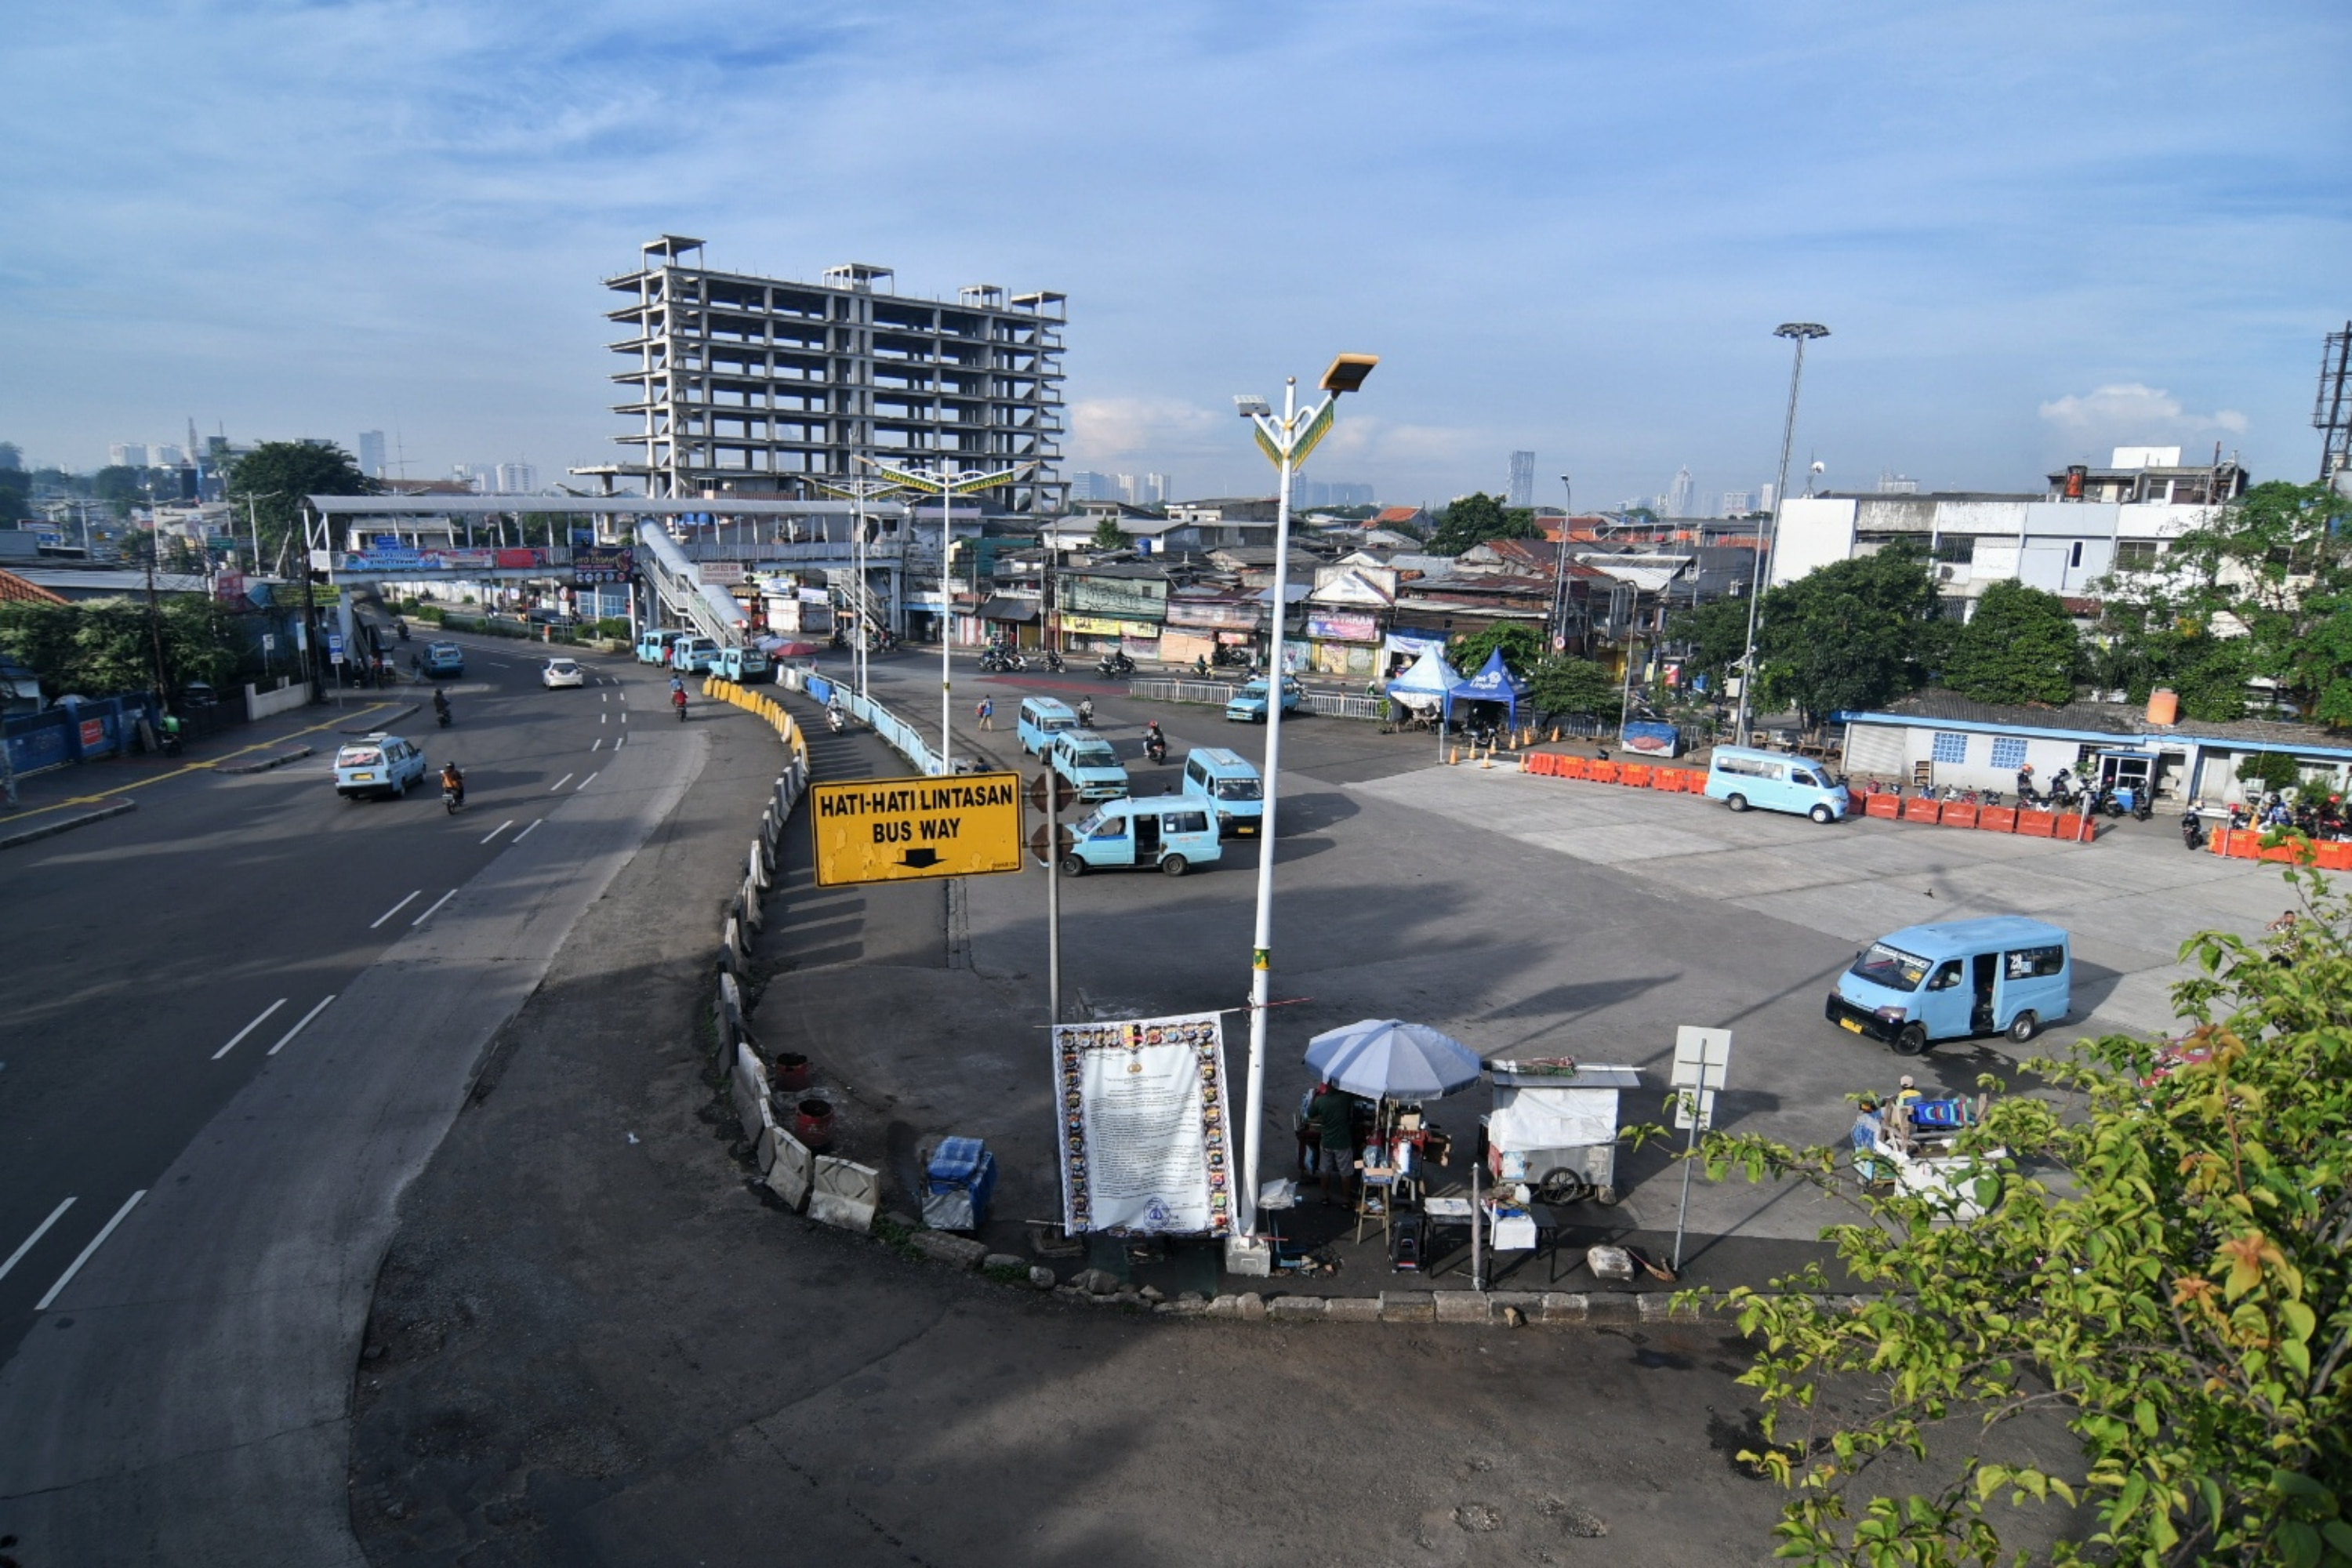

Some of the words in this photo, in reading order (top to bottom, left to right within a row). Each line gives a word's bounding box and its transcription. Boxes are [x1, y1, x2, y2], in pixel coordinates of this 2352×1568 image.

[820, 790, 916, 818] HATI-HATI
[920, 784, 1013, 811] LINTASAN
[873, 820, 912, 844] BUS
[919, 817, 960, 840] WAY
